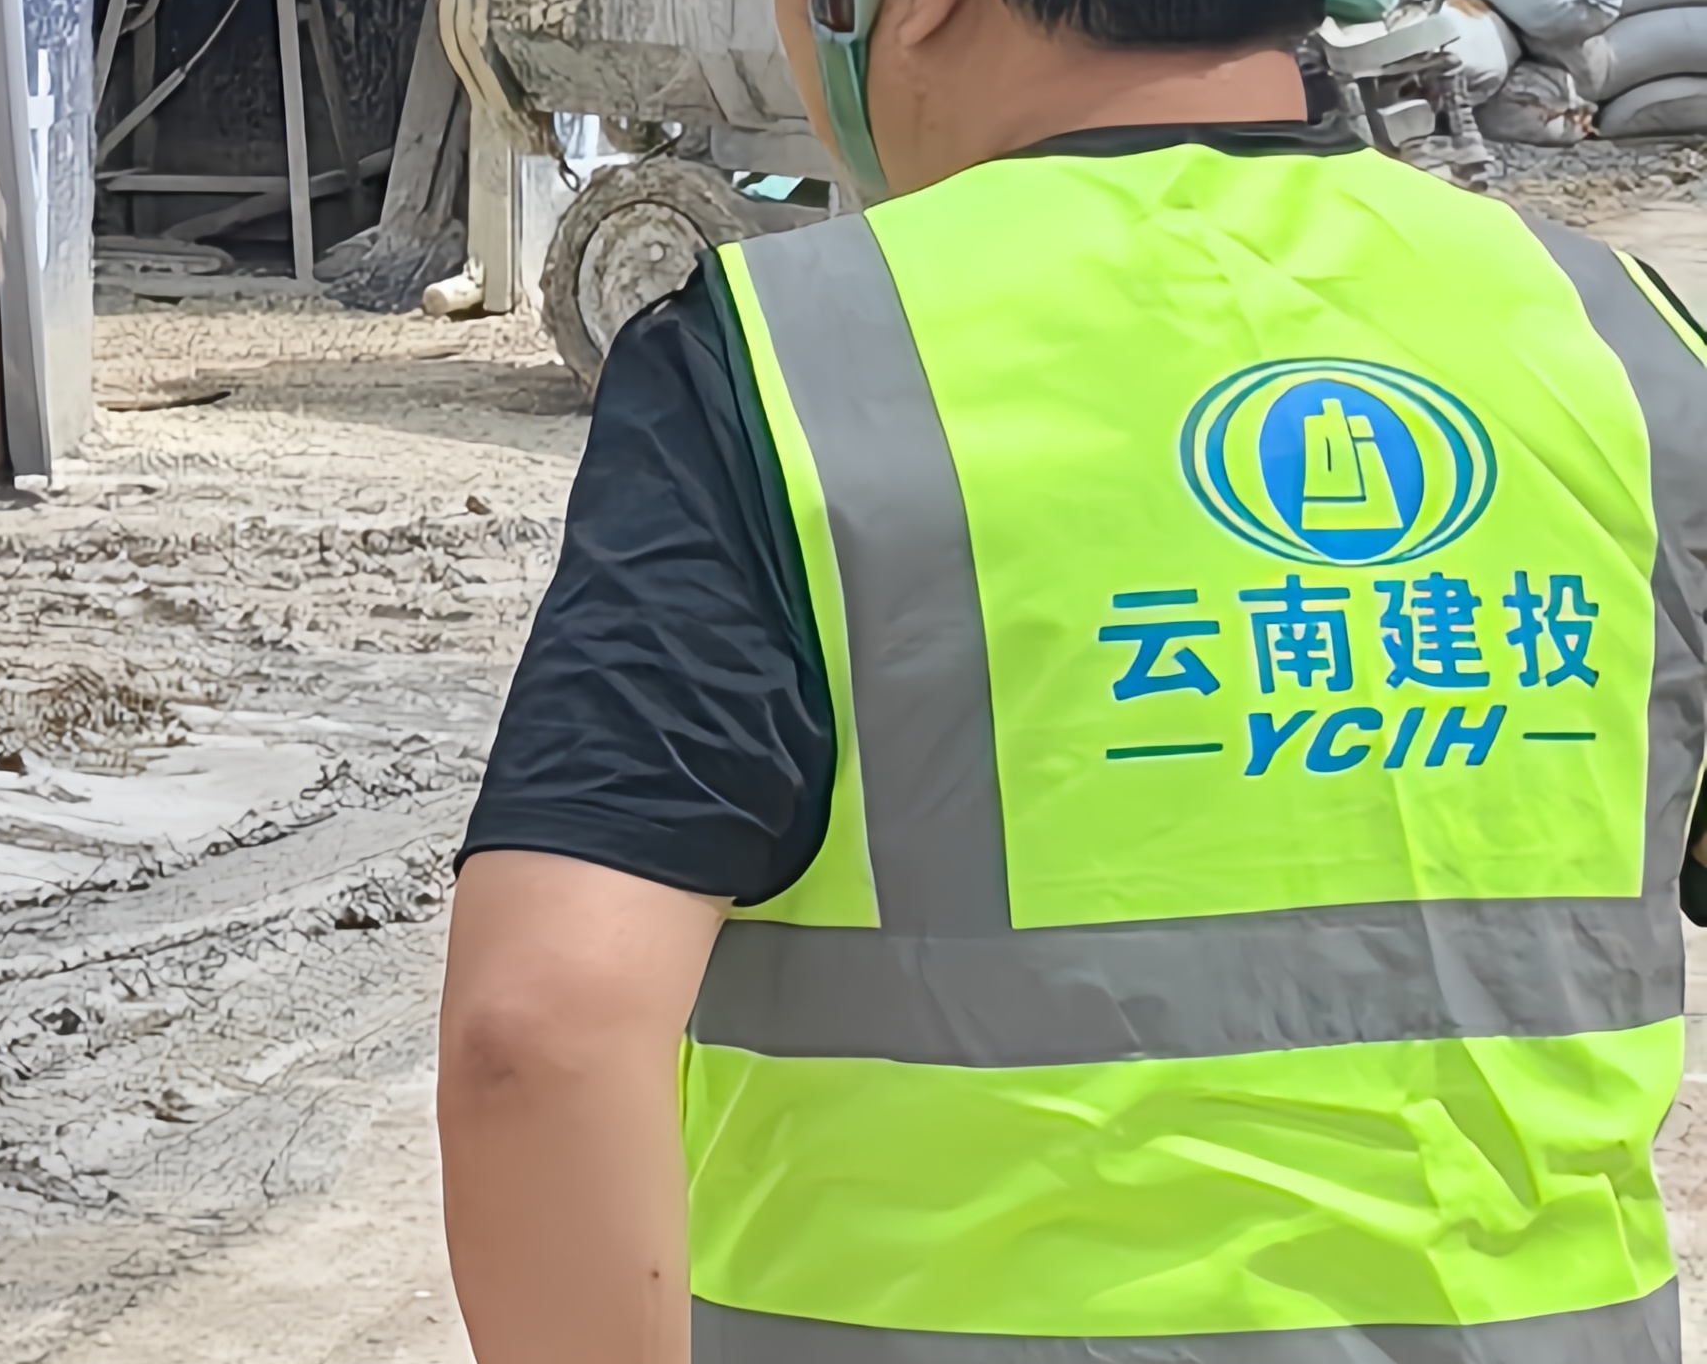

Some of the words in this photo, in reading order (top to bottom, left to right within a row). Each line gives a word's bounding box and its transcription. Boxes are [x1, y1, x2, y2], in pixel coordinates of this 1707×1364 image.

[1098, 571, 1599, 701] 云南建投
[1244, 704, 1507, 777] YCIH
